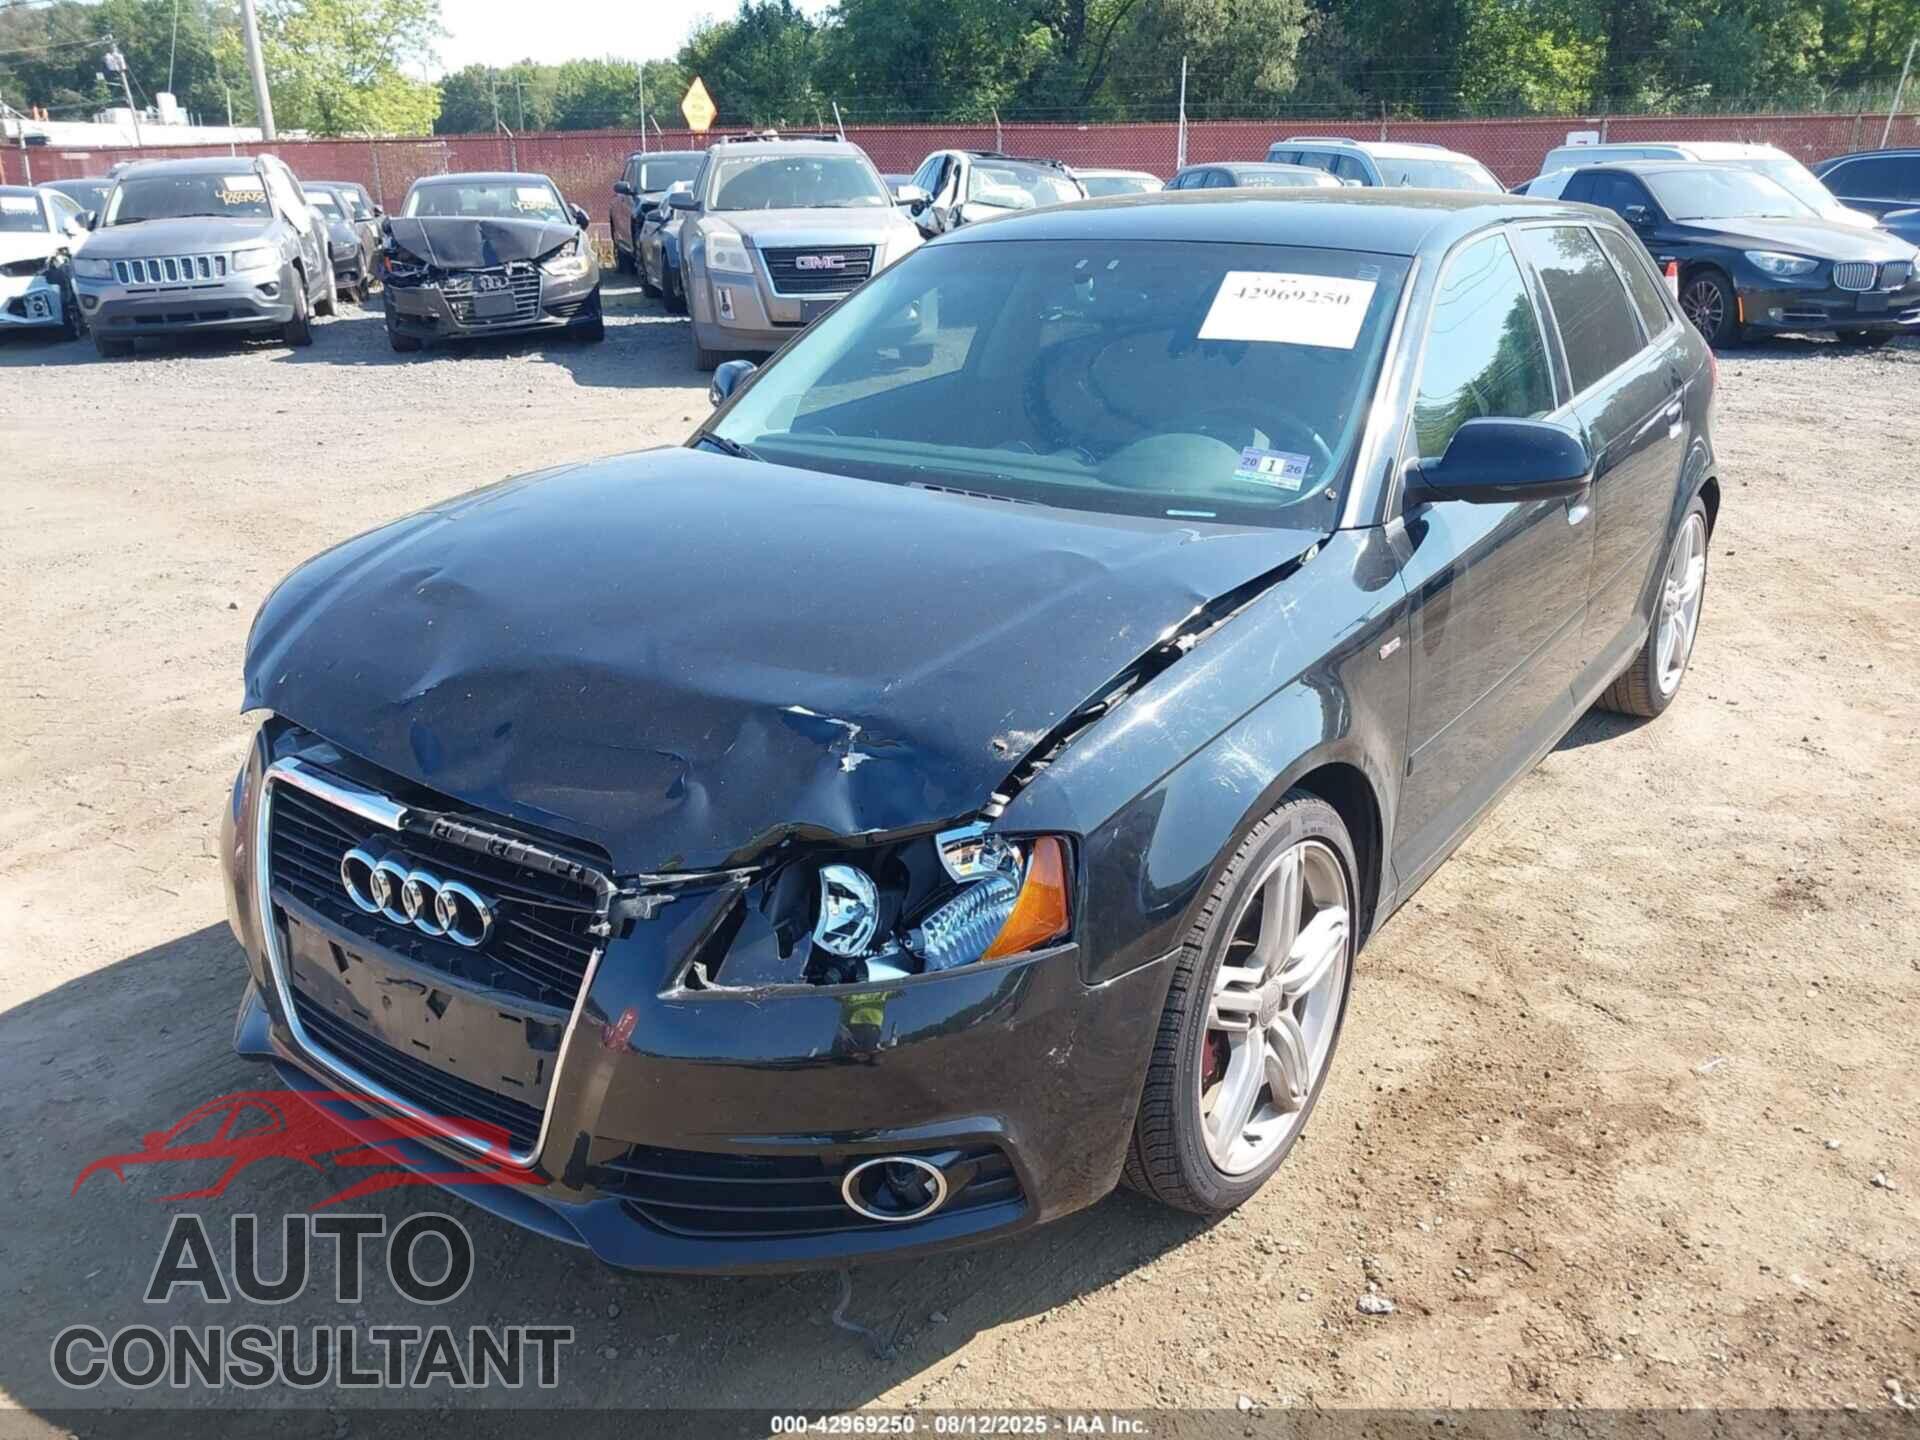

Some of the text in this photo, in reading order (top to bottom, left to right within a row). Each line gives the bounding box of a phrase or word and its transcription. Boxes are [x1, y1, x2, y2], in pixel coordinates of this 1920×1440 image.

[795, 255, 846, 270] GMC
[1232, 286, 1351, 306] 42969250
[1241, 457, 1302, 474] 20 1 26
